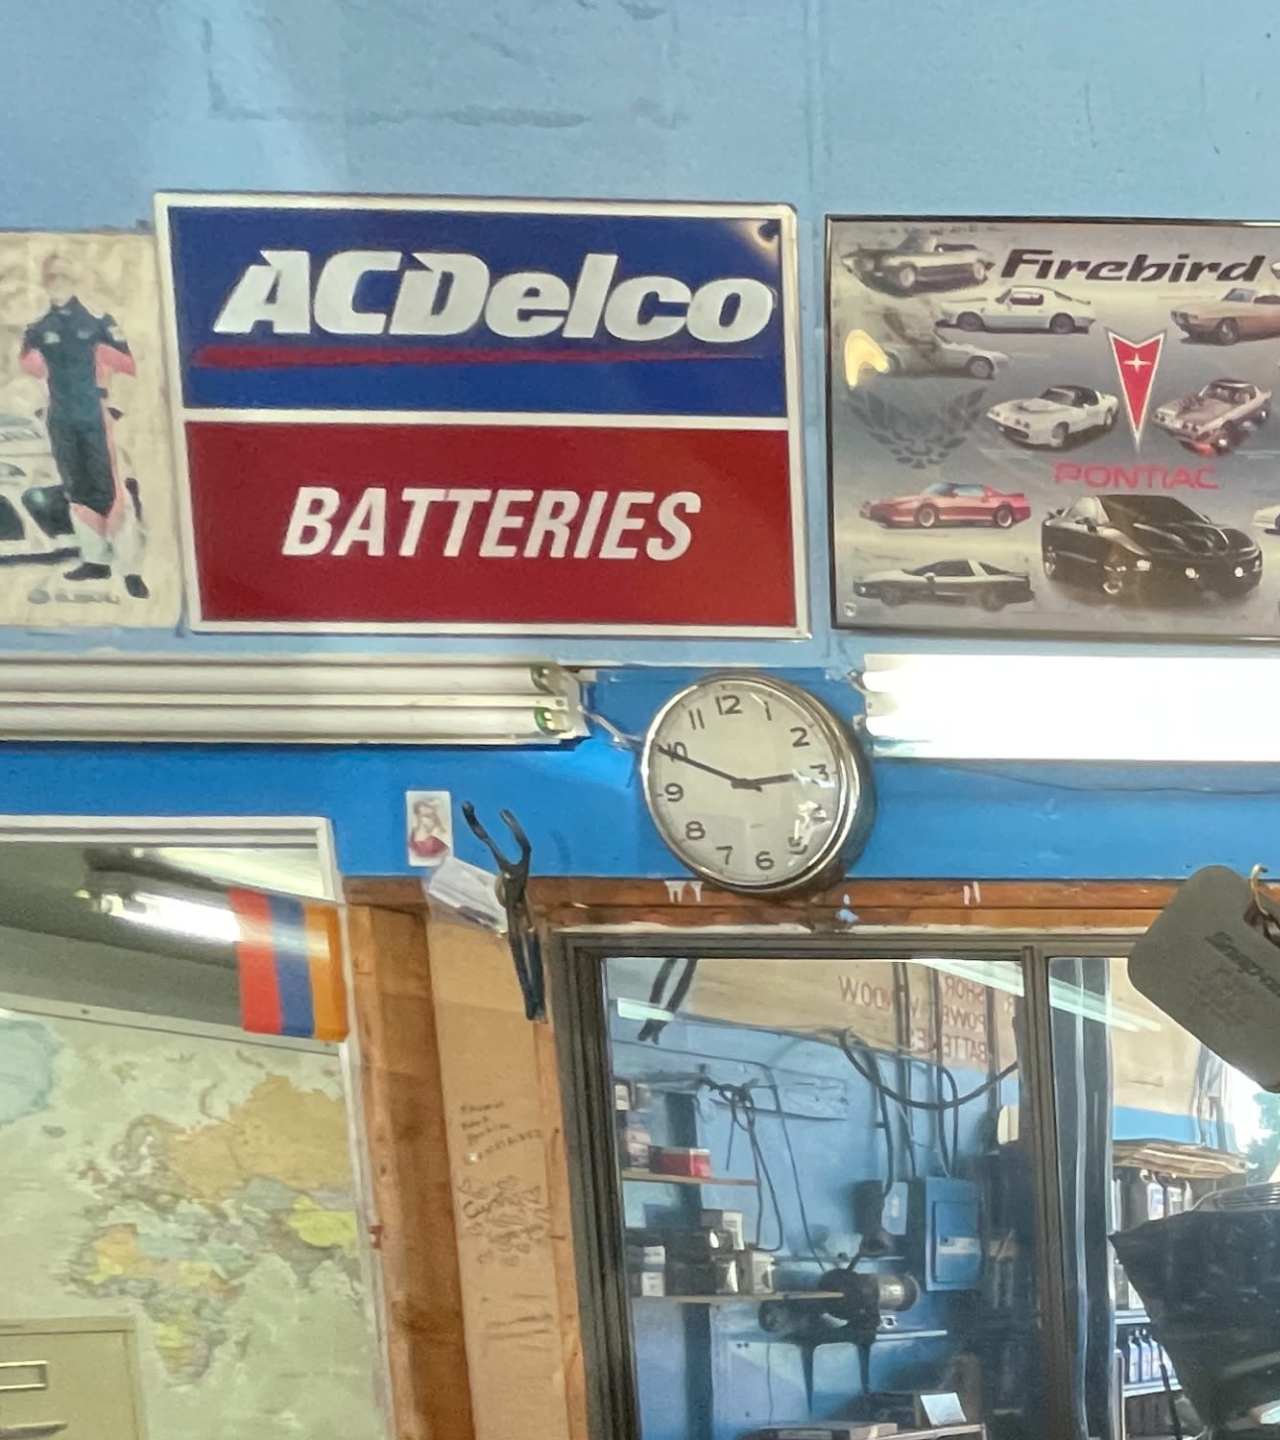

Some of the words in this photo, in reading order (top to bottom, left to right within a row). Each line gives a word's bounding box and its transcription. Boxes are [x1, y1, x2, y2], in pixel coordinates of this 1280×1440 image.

[1000, 248, 1266, 283] Firebird
[213, 248, 777, 343] ACDelco
[1055, 462, 1219, 490] PONTIAC
[281, 484, 701, 562] BATTERIES
[715, 694, 743, 717] 12
[688, 708, 706, 731] 11
[790, 726, 811, 749] 2
[664, 782, 686, 803] 9
[685, 821, 707, 841] 8
[716, 846, 734, 866] 7
[755, 851, 776, 871] 6
